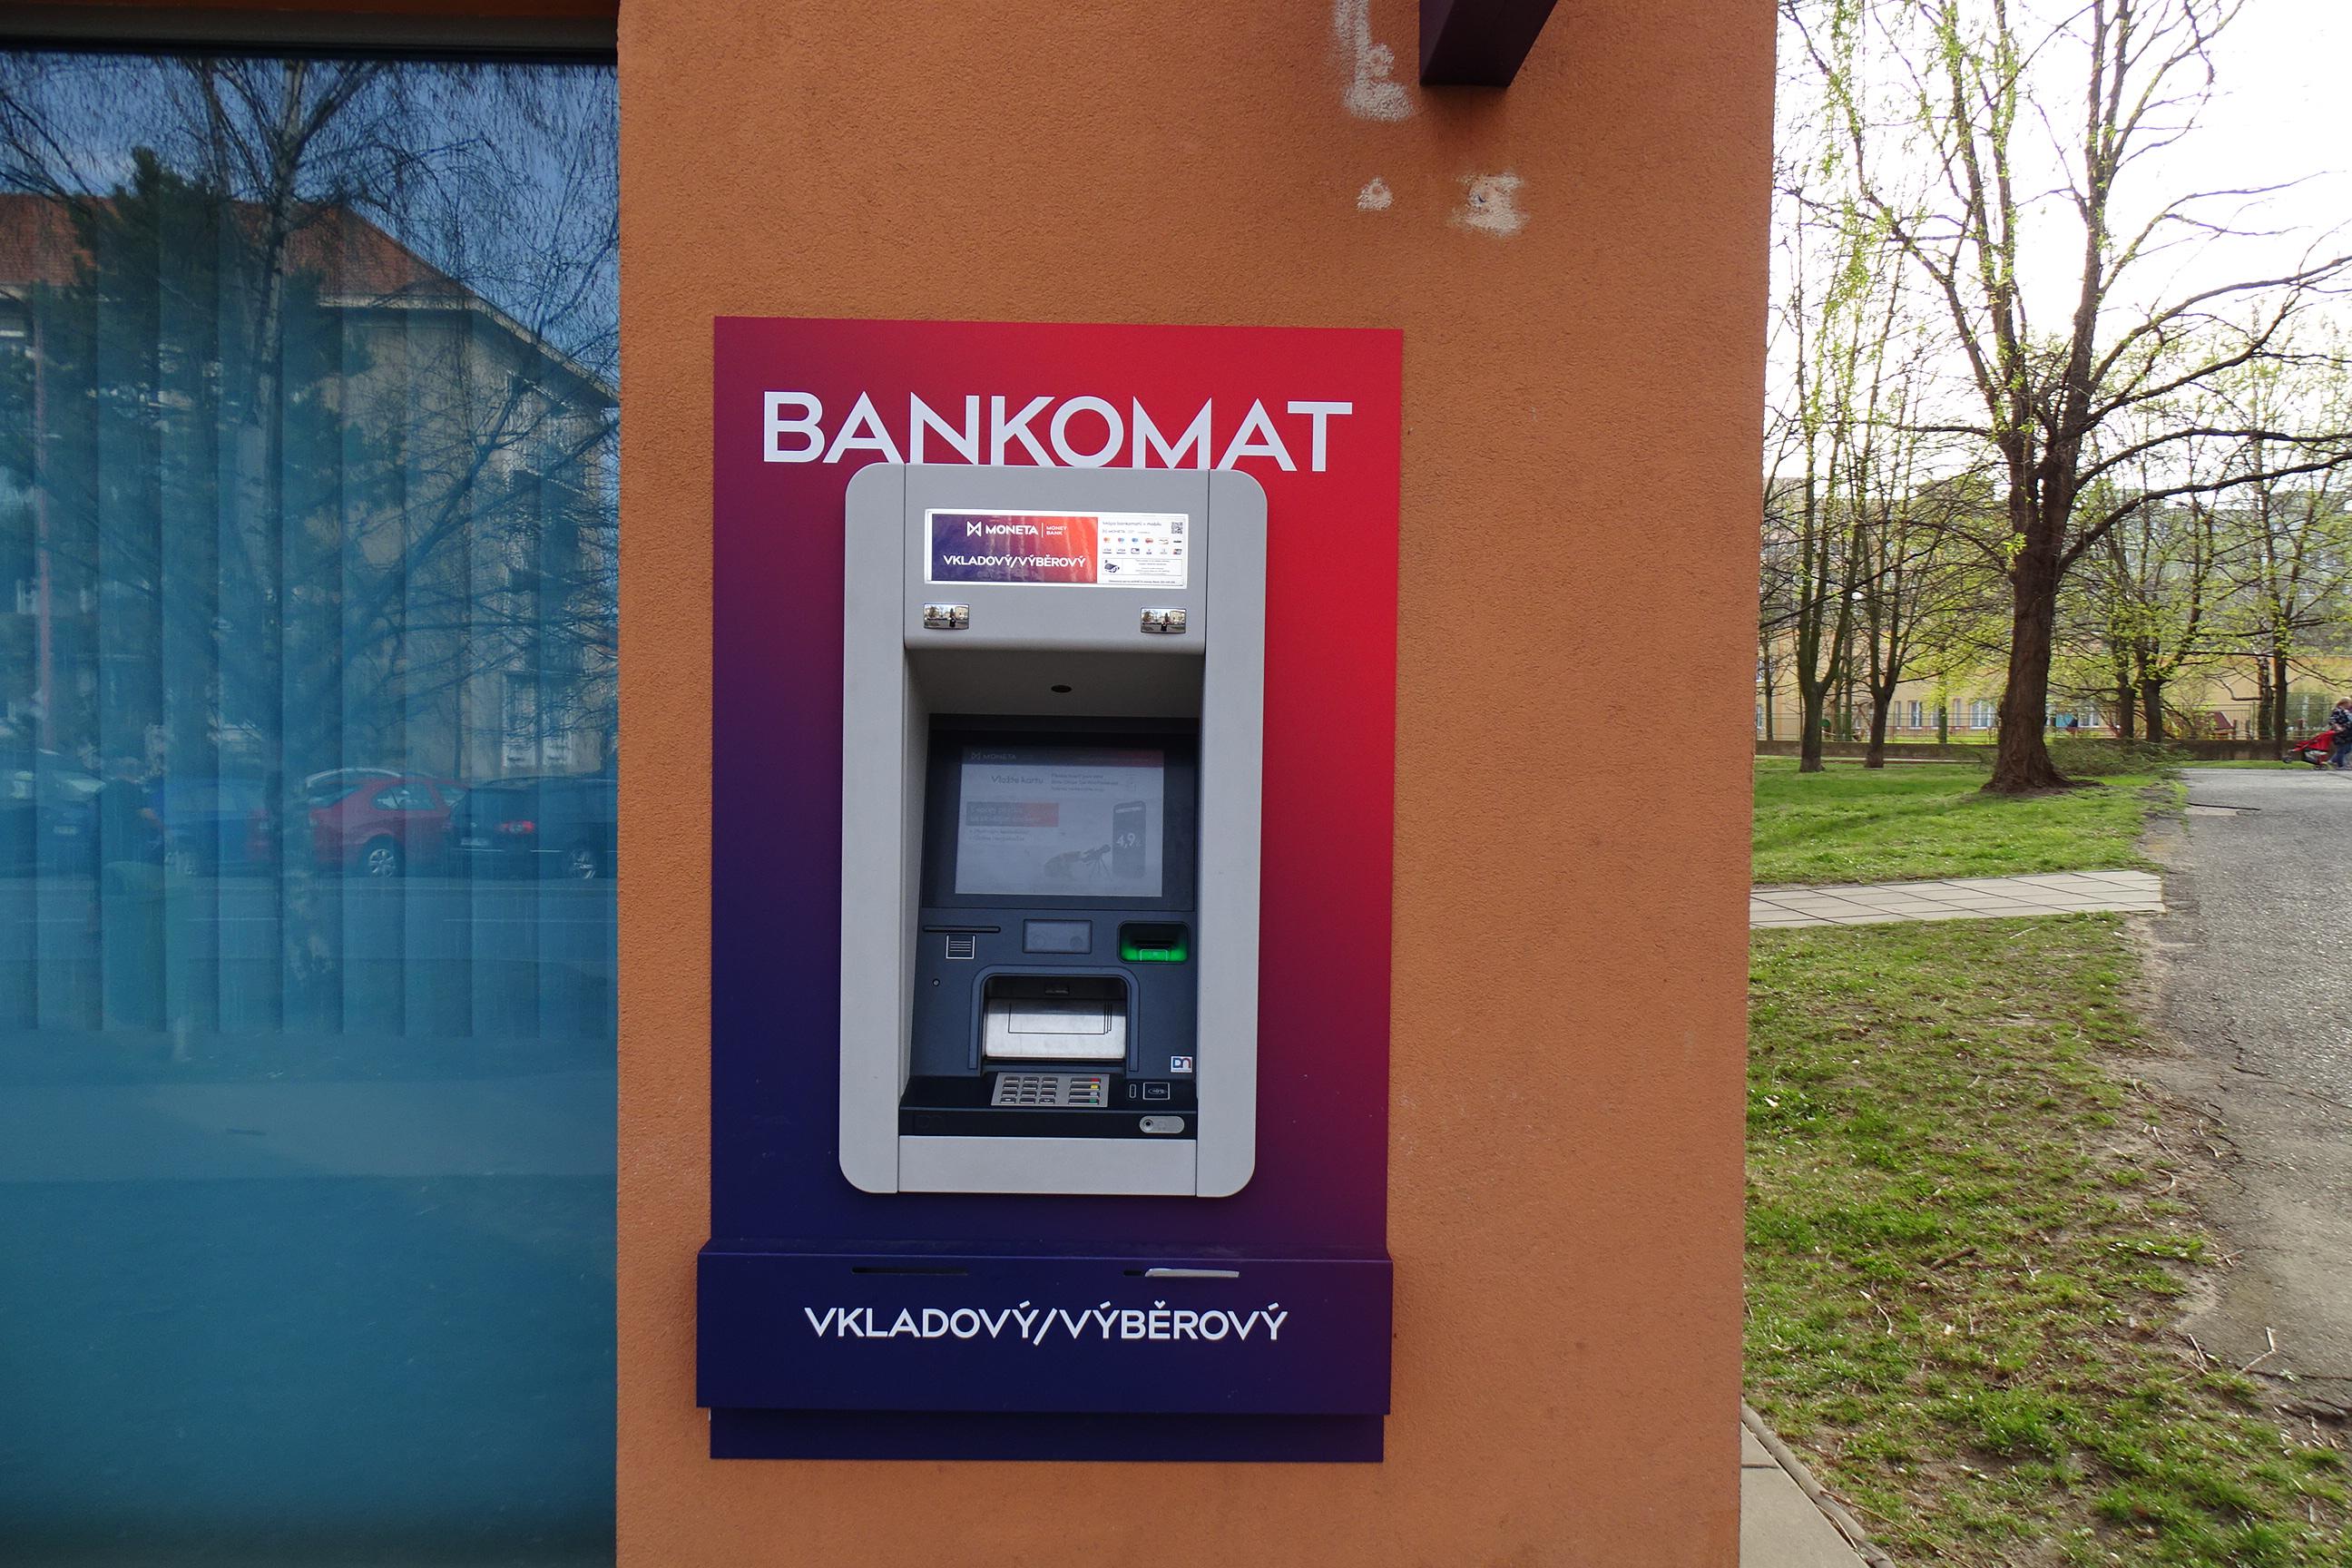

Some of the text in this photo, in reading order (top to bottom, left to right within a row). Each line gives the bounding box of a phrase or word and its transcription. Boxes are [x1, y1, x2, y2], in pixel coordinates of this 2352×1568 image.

[763, 391, 1353, 472] BANKOMAT
[985, 524, 1039, 535] MONETA
[943, 554, 1087, 568] VKLADOVÝ/VÝBĚROVÝ
[1020, 776, 1044, 785] kartu
[804, 1299, 1288, 1346] VKLADOVÝ/VÝBĚROVÝ
